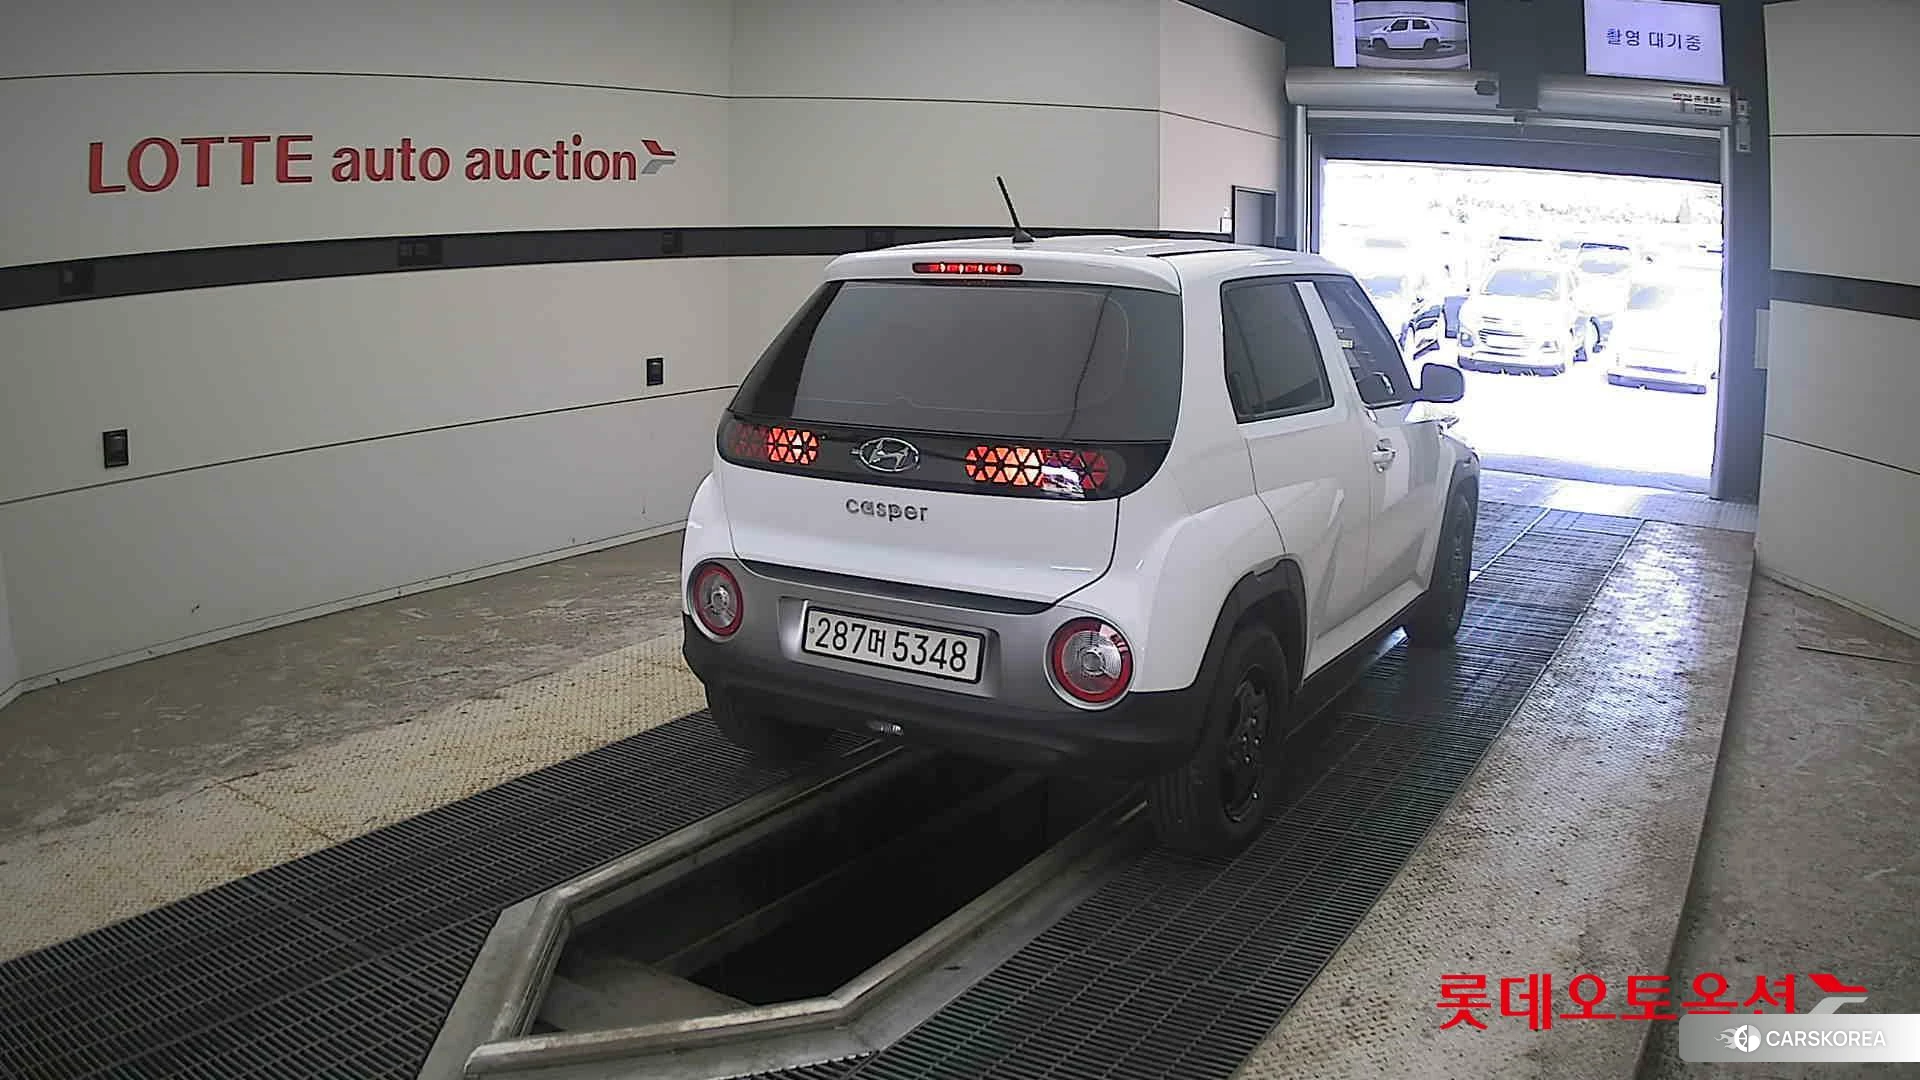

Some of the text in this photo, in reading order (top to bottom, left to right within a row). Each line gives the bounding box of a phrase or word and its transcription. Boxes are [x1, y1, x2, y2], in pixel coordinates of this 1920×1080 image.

[89, 134, 637, 194] LOTTE auto auction
[845, 498, 928, 522] casper
